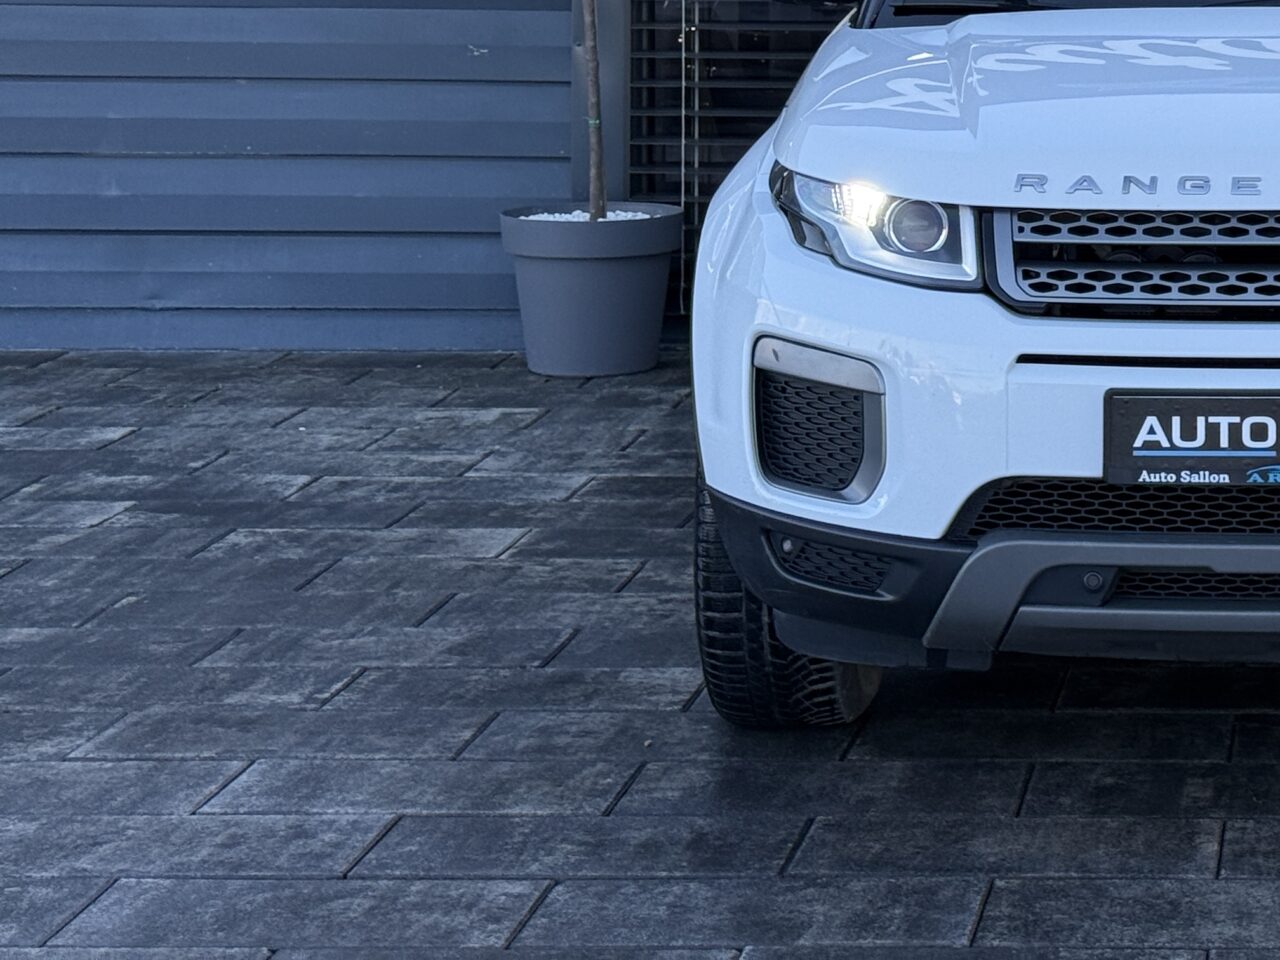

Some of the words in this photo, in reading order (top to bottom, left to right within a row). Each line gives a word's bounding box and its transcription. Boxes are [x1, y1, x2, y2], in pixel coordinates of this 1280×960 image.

[1014, 173, 1262, 195] RANGE
[1132, 415, 1277, 448] AUTO
[1138, 470, 1177, 483] Auto
[1180, 470, 1230, 483] Sallon
